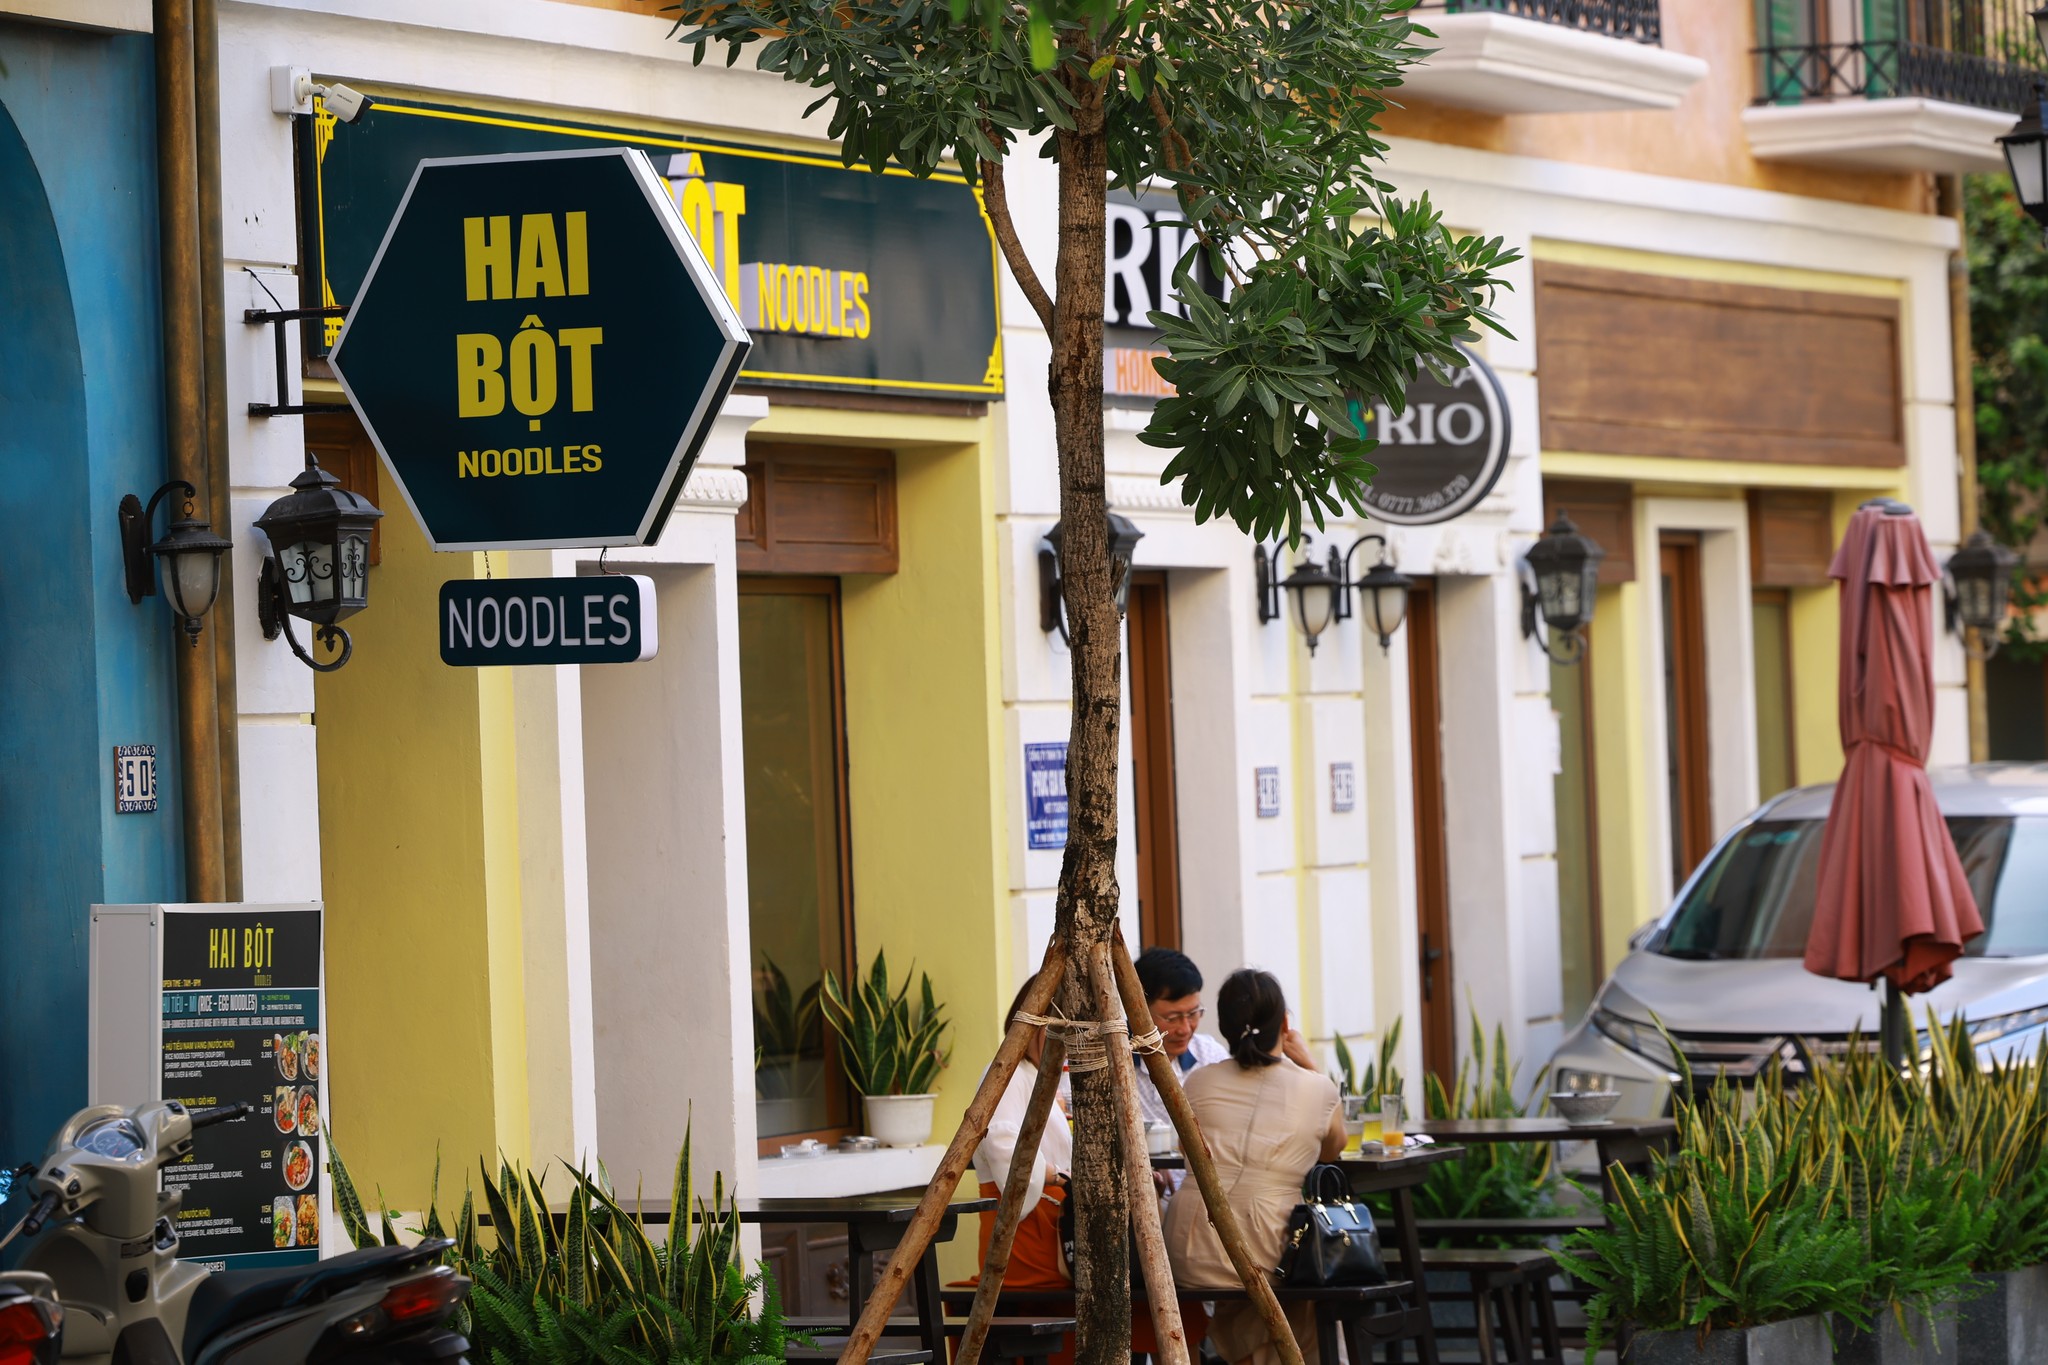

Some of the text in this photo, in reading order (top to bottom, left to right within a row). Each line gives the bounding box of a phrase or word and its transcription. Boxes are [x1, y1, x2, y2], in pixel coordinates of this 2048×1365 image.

[463, 211, 589, 301] HAI
[757, 261, 870, 339] NOODLES
[456, 314, 603, 431] BỘT
[1375, 402, 1485, 446] RIO
[457, 444, 603, 478] NOODLES
[448, 594, 632, 649] NOODLES
[126, 760, 149, 797] 50
[209, 922, 274, 974] HAI BỘT
